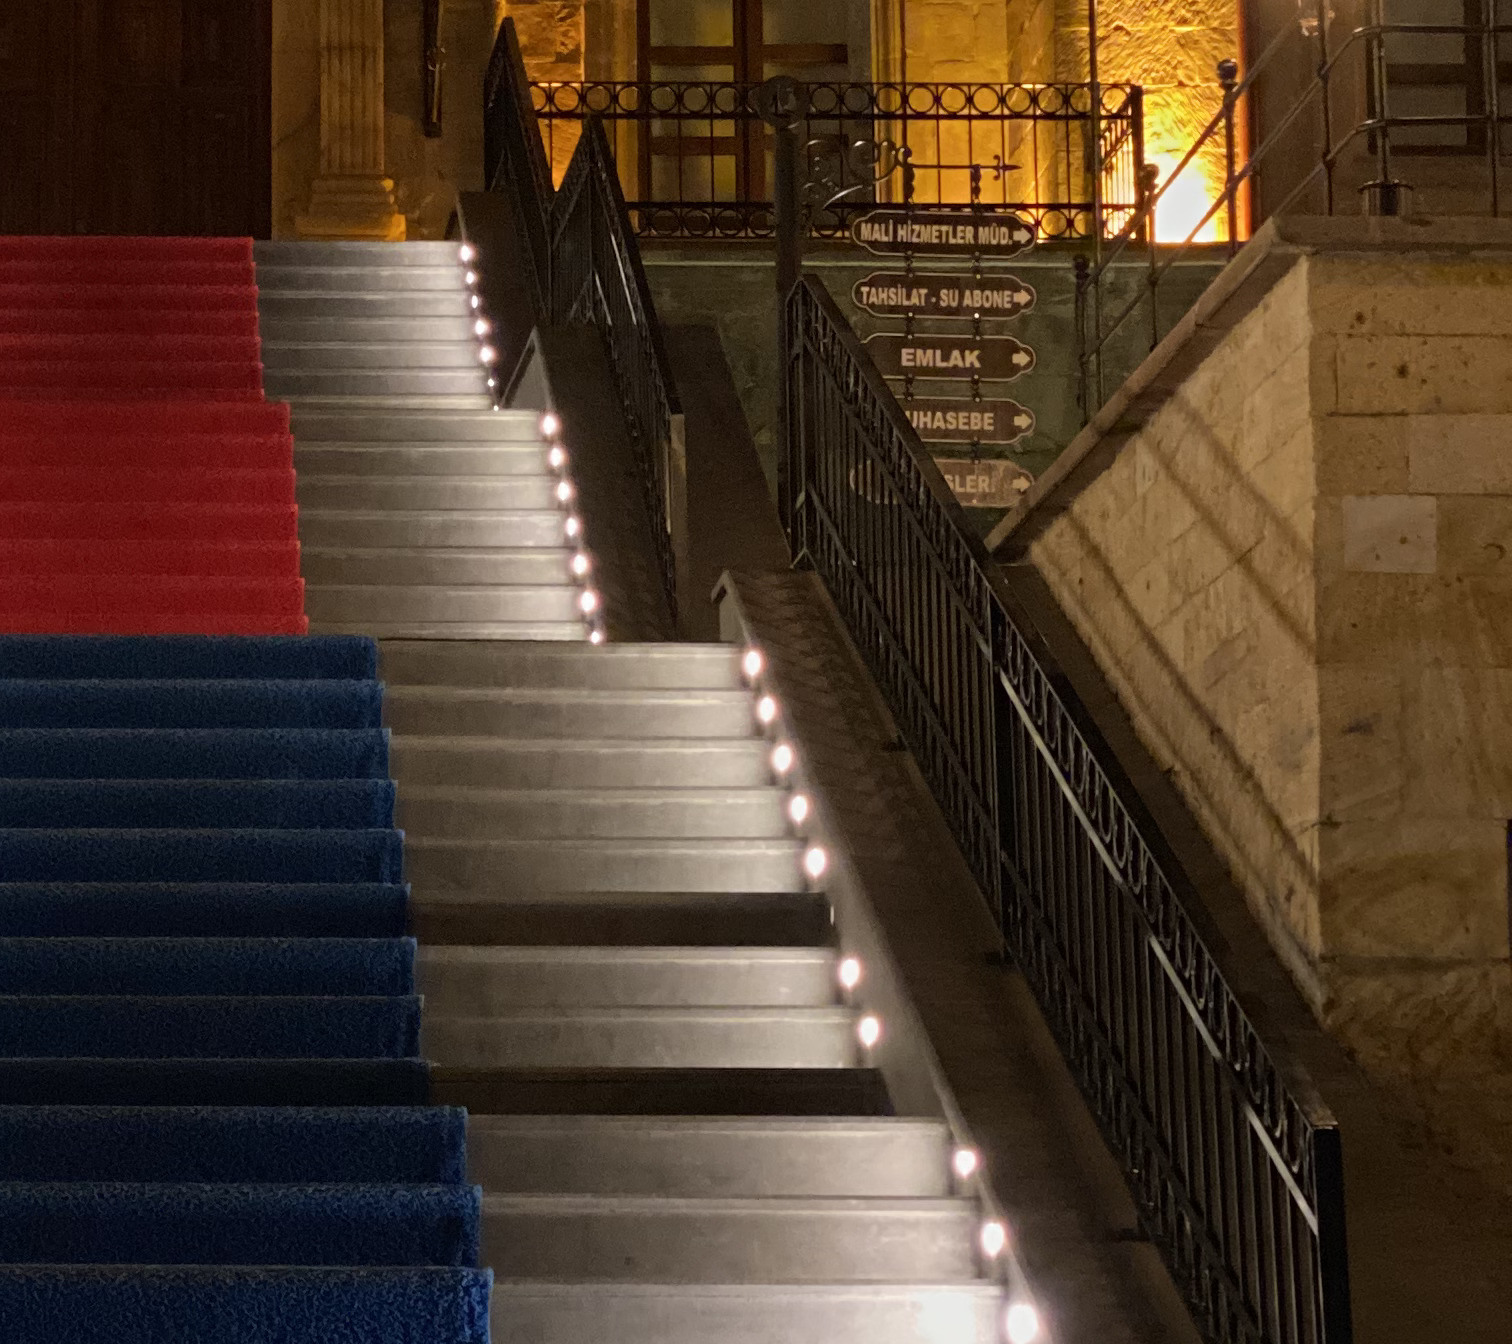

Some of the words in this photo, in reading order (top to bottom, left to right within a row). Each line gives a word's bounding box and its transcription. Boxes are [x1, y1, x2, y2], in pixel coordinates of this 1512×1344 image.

[860, 218, 894, 243] MALİ
[897, 219, 975, 245] HİZMETLER
[978, 222, 1013, 245] MÜD.
[860, 283, 929, 307] TAHSİLAT
[939, 288, 960, 307] SU
[962, 289, 1013, 309] ABONE
[900, 347, 982, 369] EMLAK
[905, 411, 995, 432] UHASEBE
